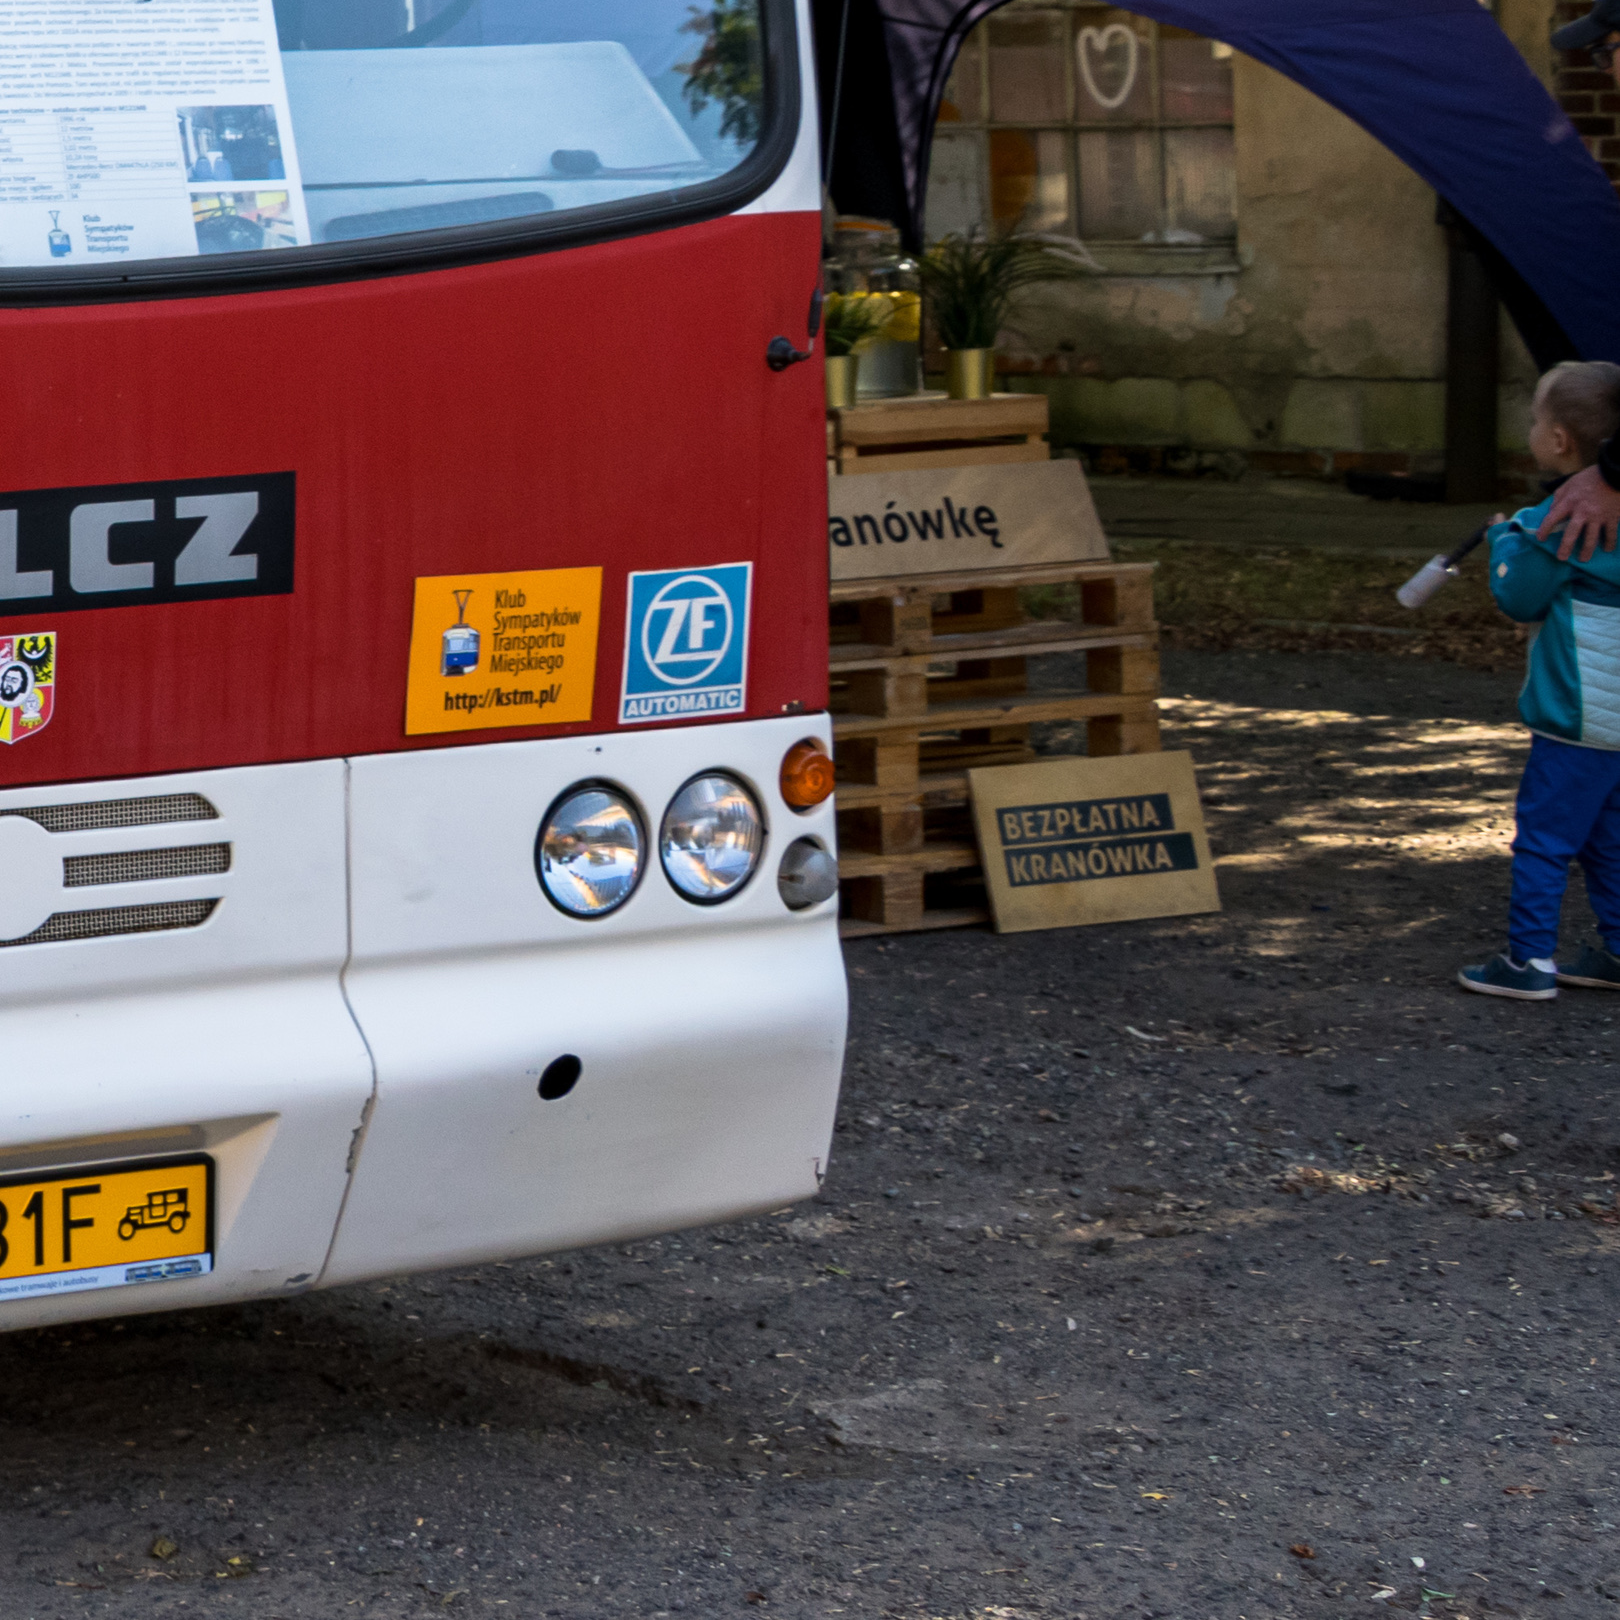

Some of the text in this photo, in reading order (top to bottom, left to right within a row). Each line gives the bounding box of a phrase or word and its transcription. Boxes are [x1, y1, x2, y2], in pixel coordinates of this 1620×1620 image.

[494, 589, 526, 609] Klub
[493, 607, 581, 632] Sympatyków
[653, 597, 727, 664] ZF
[492, 631, 566, 657] Transportu
[489, 652, 564, 676] Miejskiego
[444, 684, 562, 714] http://kstm.pl/
[625, 690, 739, 717] AUTOMATIC
[1011, 842, 1174, 883] KRANÓWKA
[21, 1280, 58, 1293] tramwaje
[63, 1275, 99, 1287] autobusy
